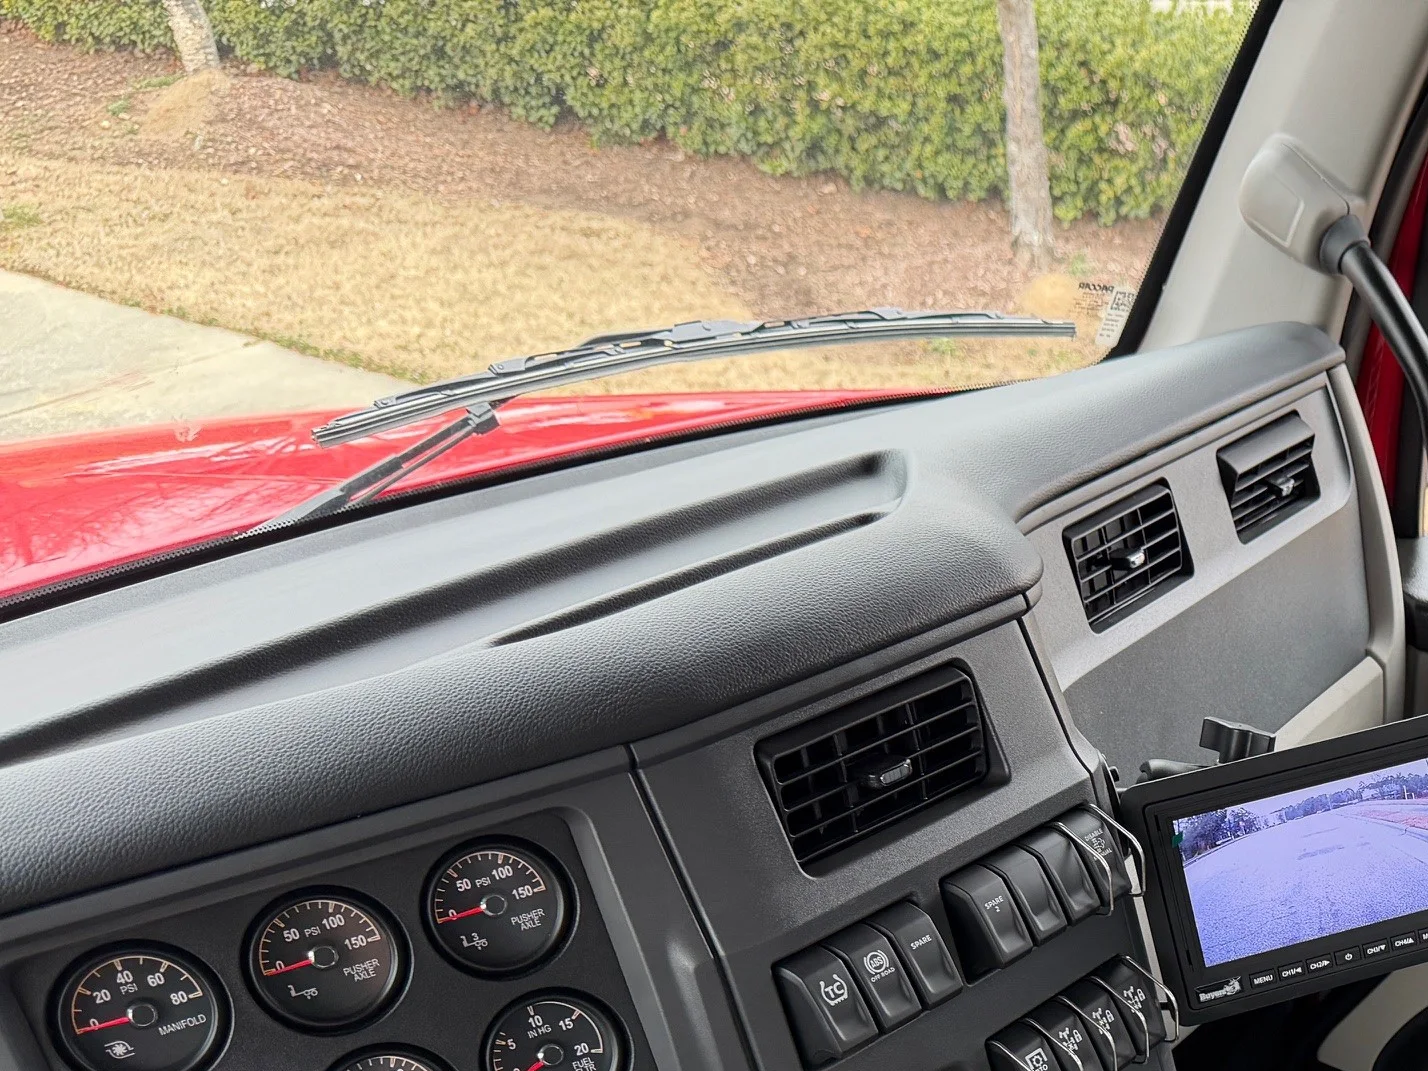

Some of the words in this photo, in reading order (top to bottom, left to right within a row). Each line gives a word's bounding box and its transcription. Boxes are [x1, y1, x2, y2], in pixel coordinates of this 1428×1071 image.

[492, 865, 513, 880] 100
[456, 878, 472, 892] 50
[475, 876, 491, 888] PSI
[512, 885, 533, 900] 150
[984, 895, 1004, 911] SPARE
[322, 914, 345, 930] 100
[511, 908, 545, 925] PUSHER
[304, 926, 321, 938] PSI
[520, 919, 541, 931] AXLE
[283, 928, 300, 942] 50
[344, 934, 367, 950] 150
[910, 934, 932, 950] SPARE
[343, 958, 380, 977] PUSHER
[116, 970, 133, 985] 40
[146, 973, 165, 987] 60
[354, 969, 377, 983] AXLE
[1253, 974, 1273, 985] MENU
[119, 982, 138, 995] PSI
[825, 981, 845, 999] TC
[93, 989, 111, 1004] 20
[170, 991, 187, 1005] 80
[158, 1013, 207, 1036] MANIFOLD
[528, 1015, 543, 1028] 10
[559, 1017, 574, 1031] 15
[527, 1029, 538, 1039] IN
[538, 1024, 552, 1035] HG
[507, 1039, 516, 1050] 5
[574, 1042, 589, 1056] 20
[572, 1056, 594, 1069] FUEL
